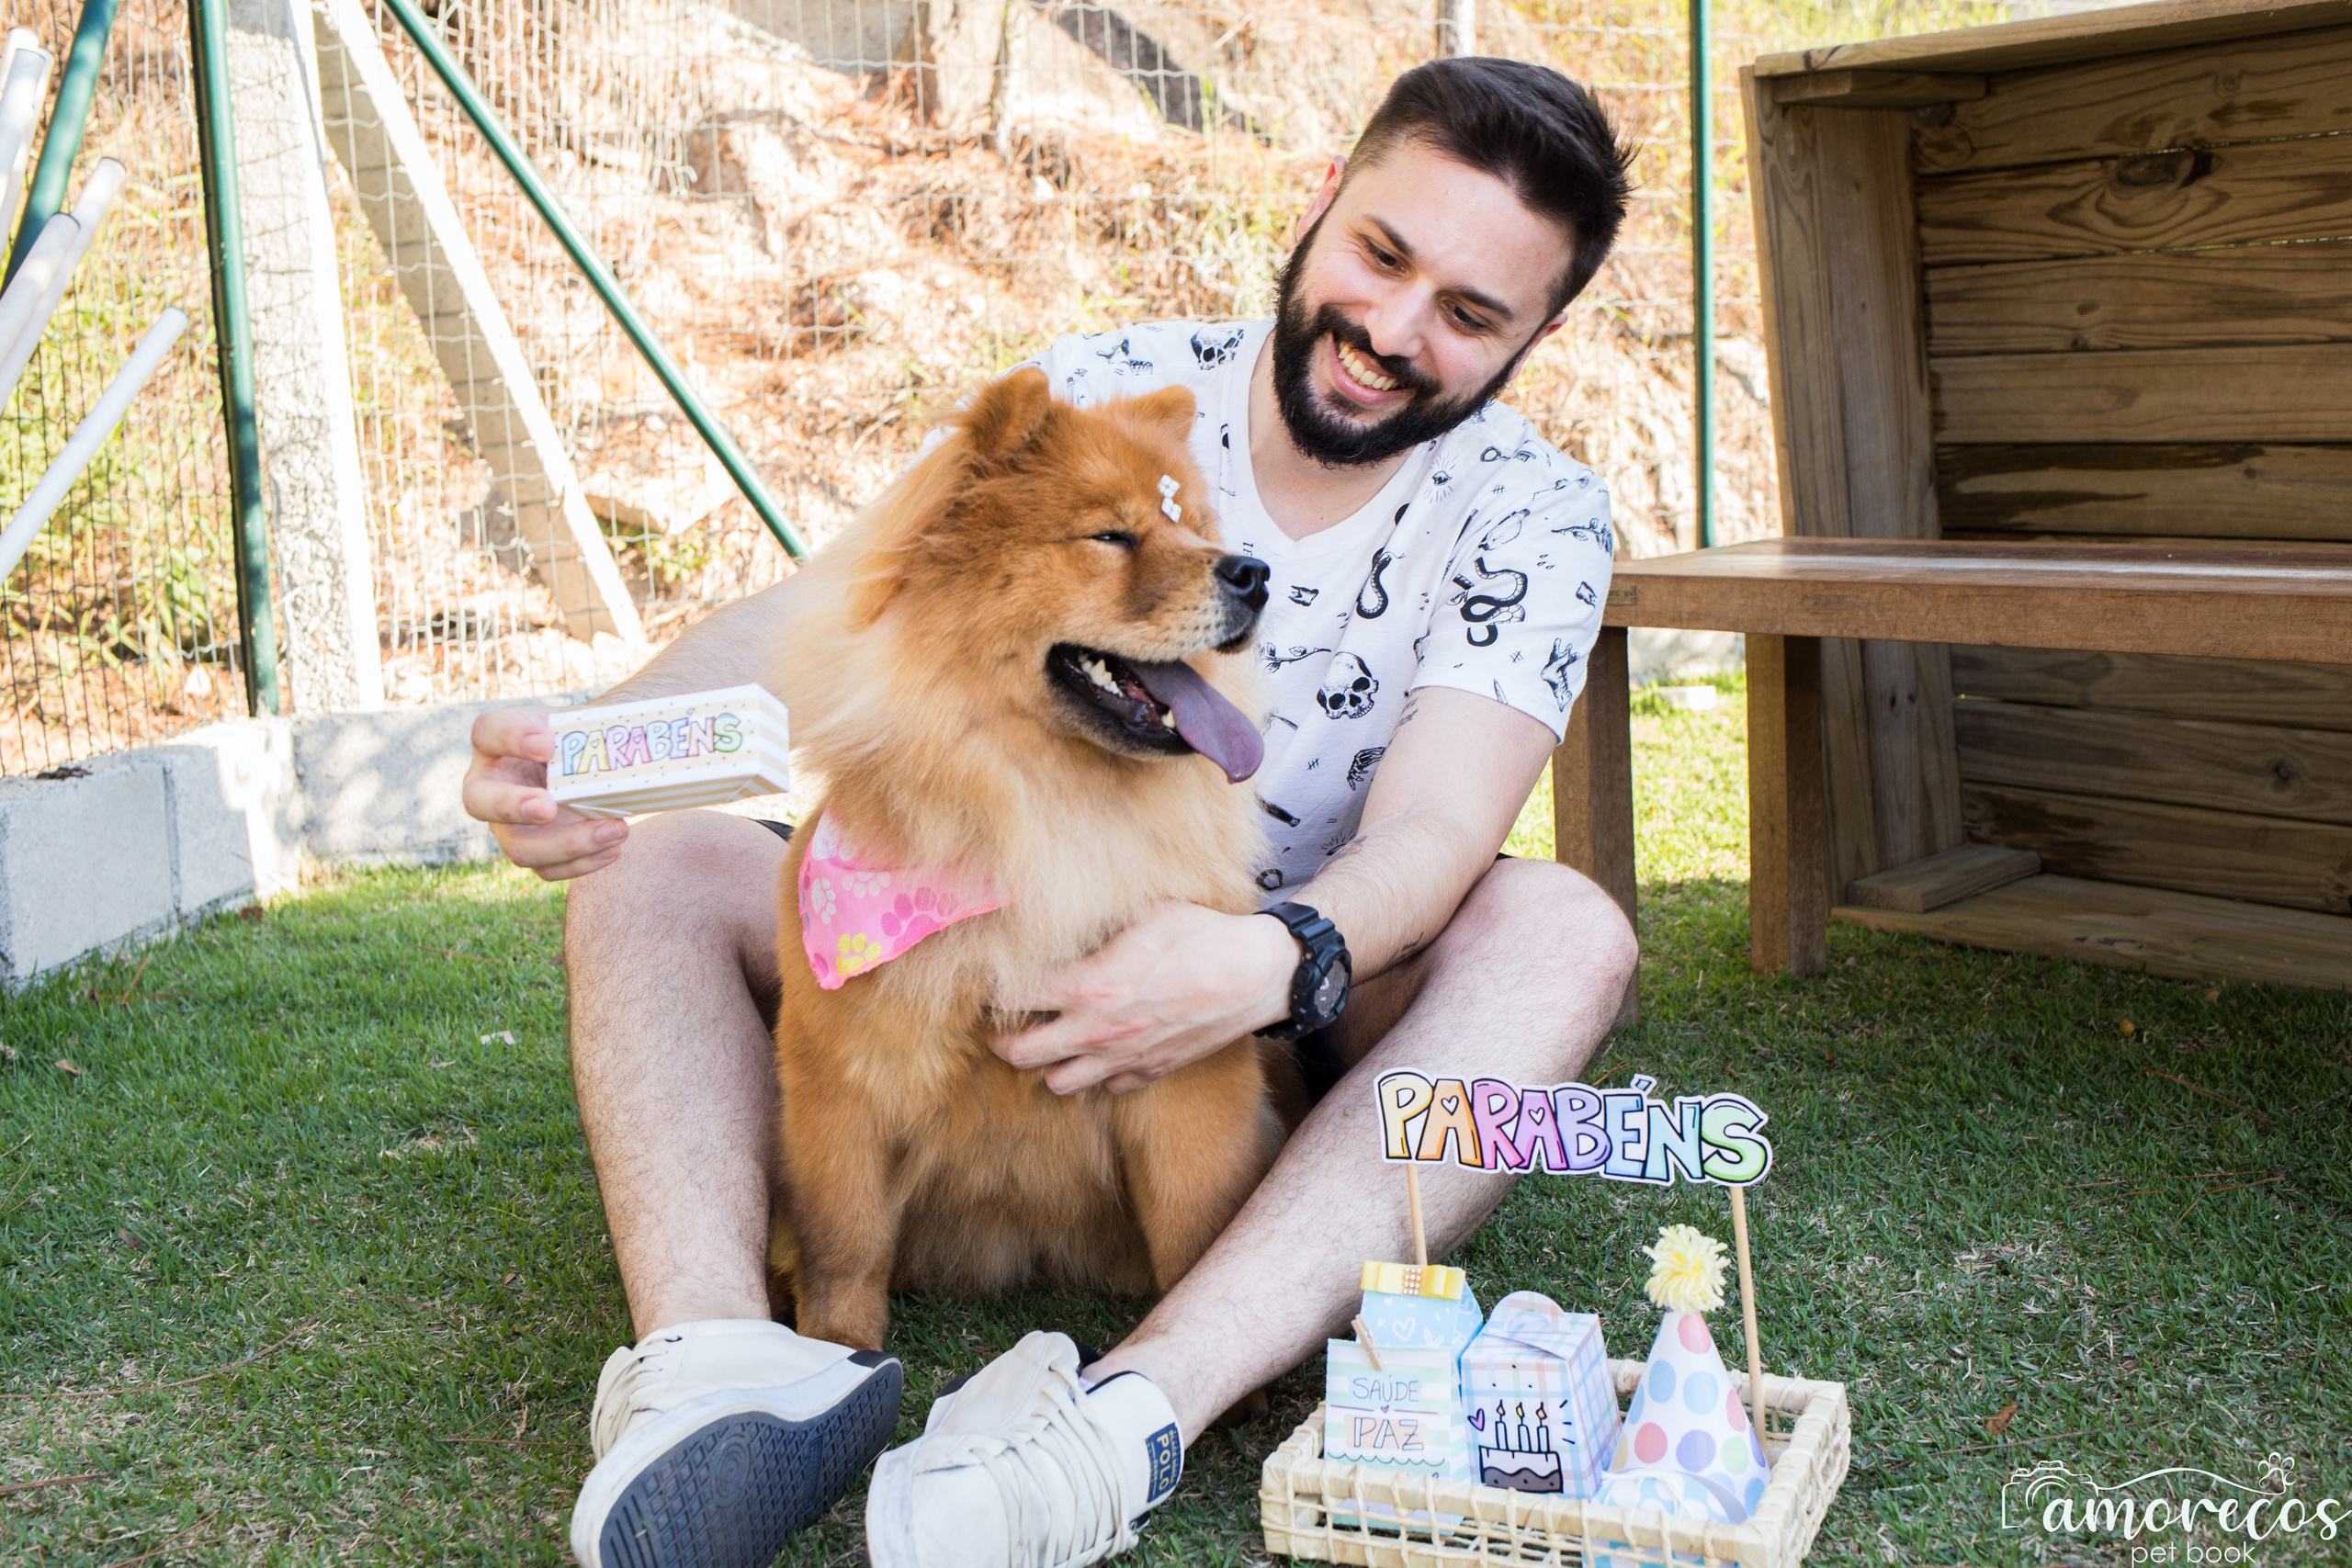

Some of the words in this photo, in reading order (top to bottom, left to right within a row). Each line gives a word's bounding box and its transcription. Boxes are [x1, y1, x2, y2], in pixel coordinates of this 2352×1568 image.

[562, 707, 742, 776] PARABÉNS
[1377, 1072, 1766, 1183] PARABÉNS
[1352, 1374, 1419, 1402] SAÚDE
[1157, 1433, 1170, 1491] POLO
[1353, 1417, 1424, 1451] PAZ
